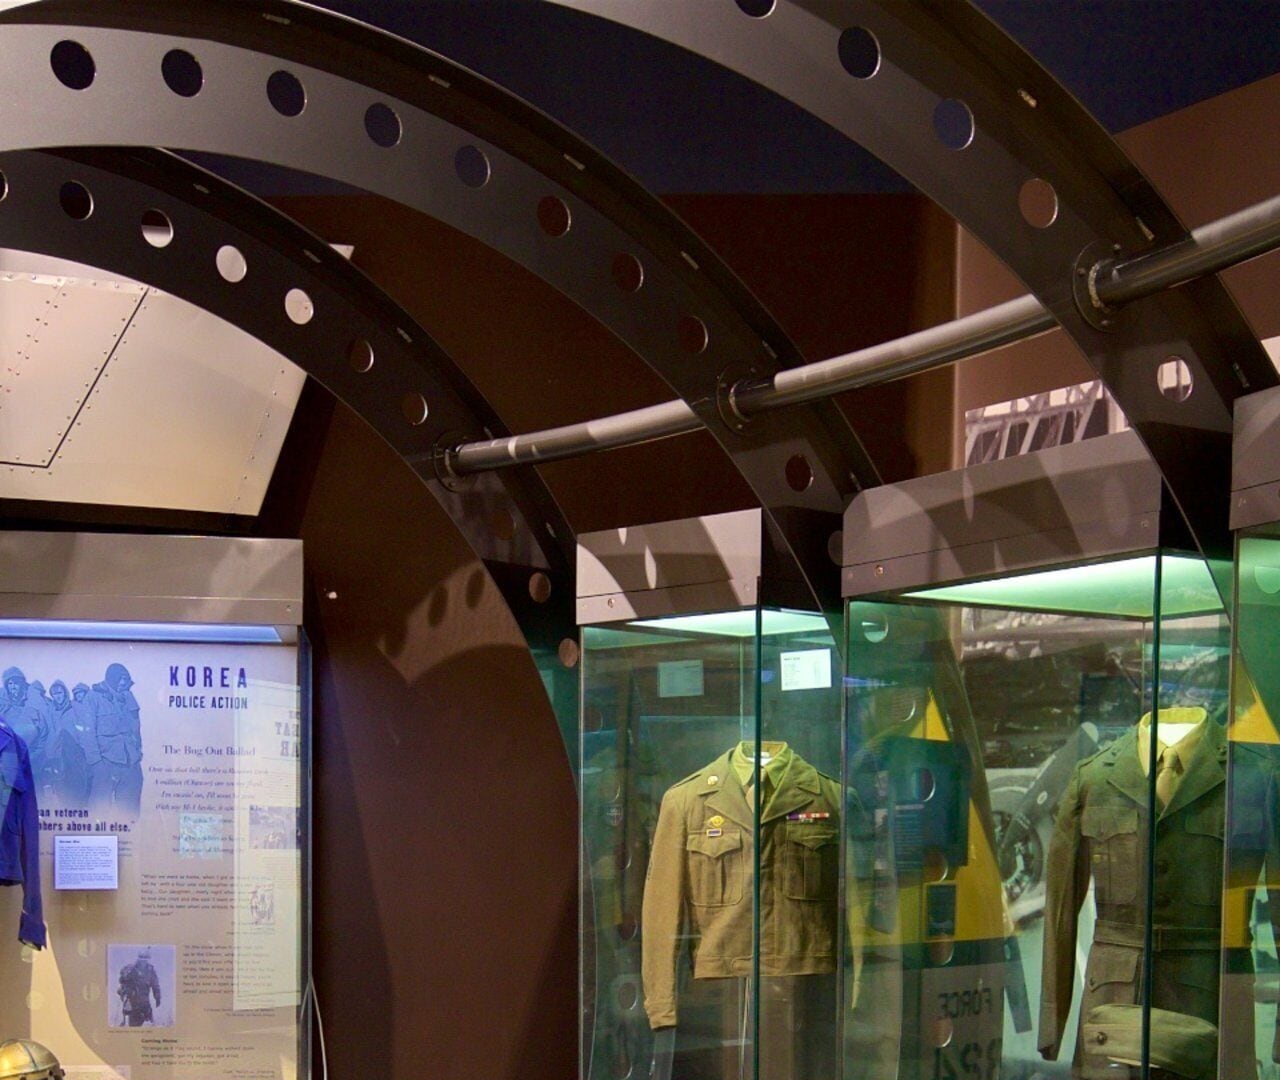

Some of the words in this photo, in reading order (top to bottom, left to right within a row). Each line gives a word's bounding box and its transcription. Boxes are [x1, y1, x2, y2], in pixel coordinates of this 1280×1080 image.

[170, 666, 247, 688] KOREA
[169, 696, 205, 709] POLICE
[212, 696, 248, 709] ACTION
[163, 745, 181, 755] The
[184, 745, 202, 757] Bug
[205, 746, 223, 756] Out
[226, 746, 256, 757] Ballad
[54, 808, 89, 818] veteran
[66, 821, 92, 832] above
[95, 821, 106, 832] all
